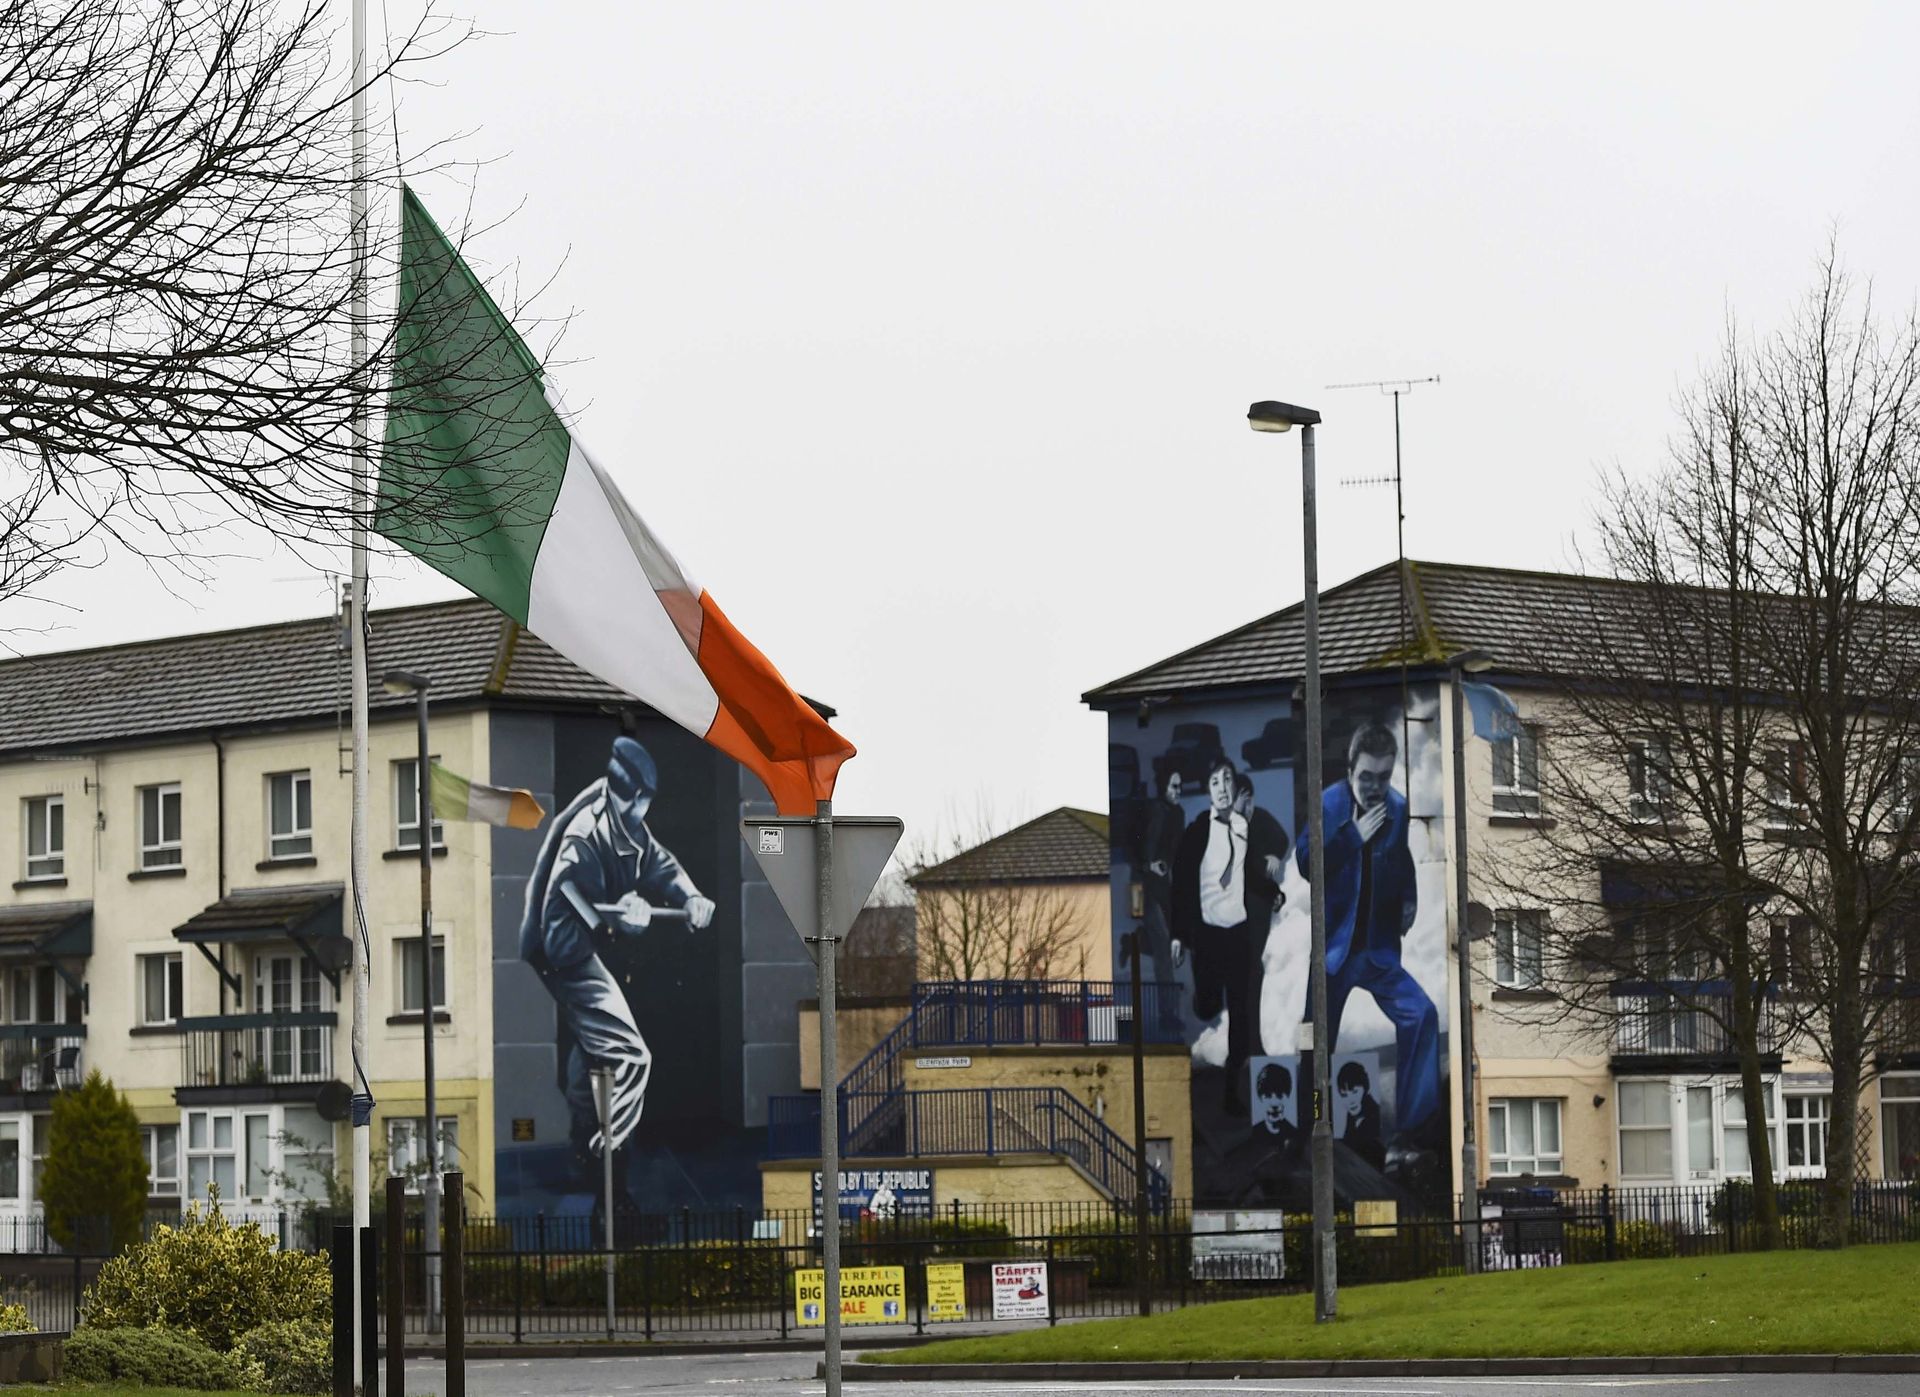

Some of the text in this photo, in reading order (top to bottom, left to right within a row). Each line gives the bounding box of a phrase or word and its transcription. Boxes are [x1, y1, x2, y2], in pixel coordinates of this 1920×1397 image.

[847, 1171, 861, 1190] BY
[863, 1171, 880, 1190] THE
[882, 1170, 930, 1190] REPUBLIC
[800, 1286, 822, 1300] BIG
[840, 1284, 901, 1298] EARANCE
